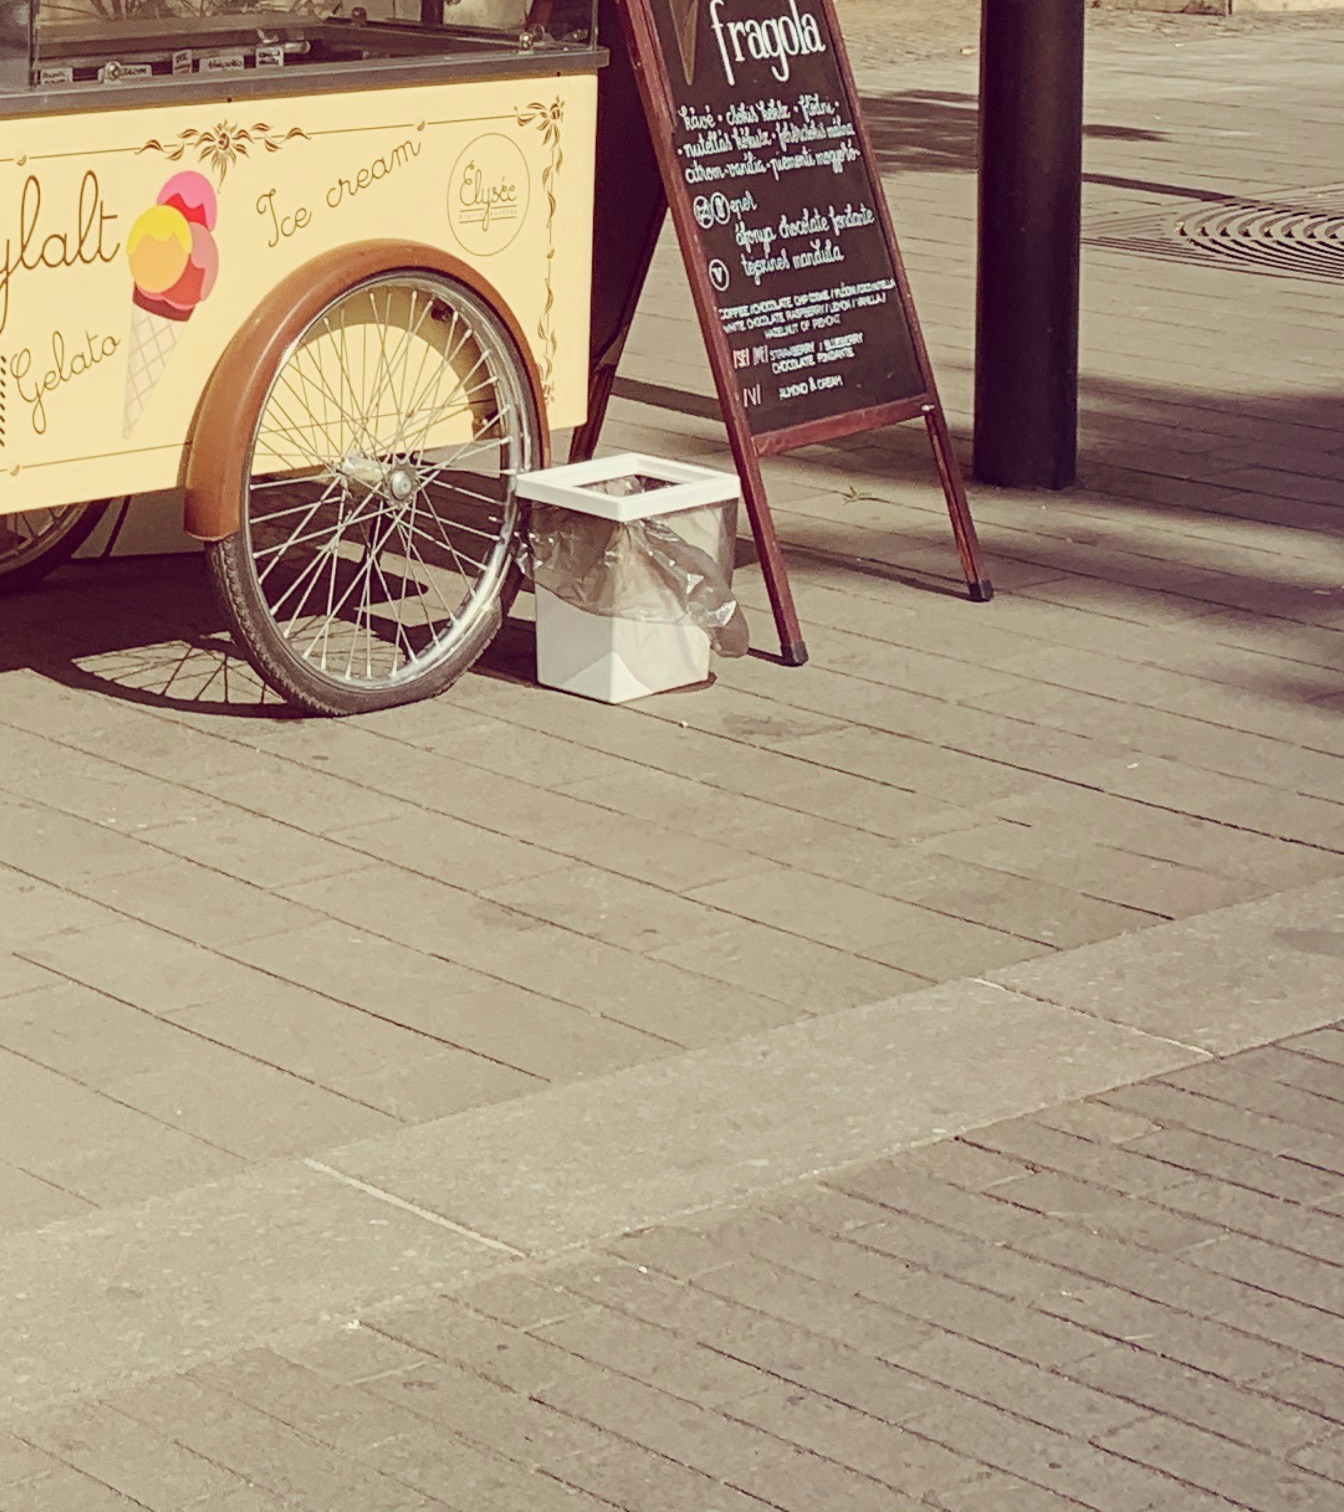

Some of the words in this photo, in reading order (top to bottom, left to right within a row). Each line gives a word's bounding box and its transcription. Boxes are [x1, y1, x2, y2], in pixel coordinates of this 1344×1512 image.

[256, 188, 313, 248] Ice
[326, 135, 422, 208] cream
[9, 330, 122, 435] Gelato
